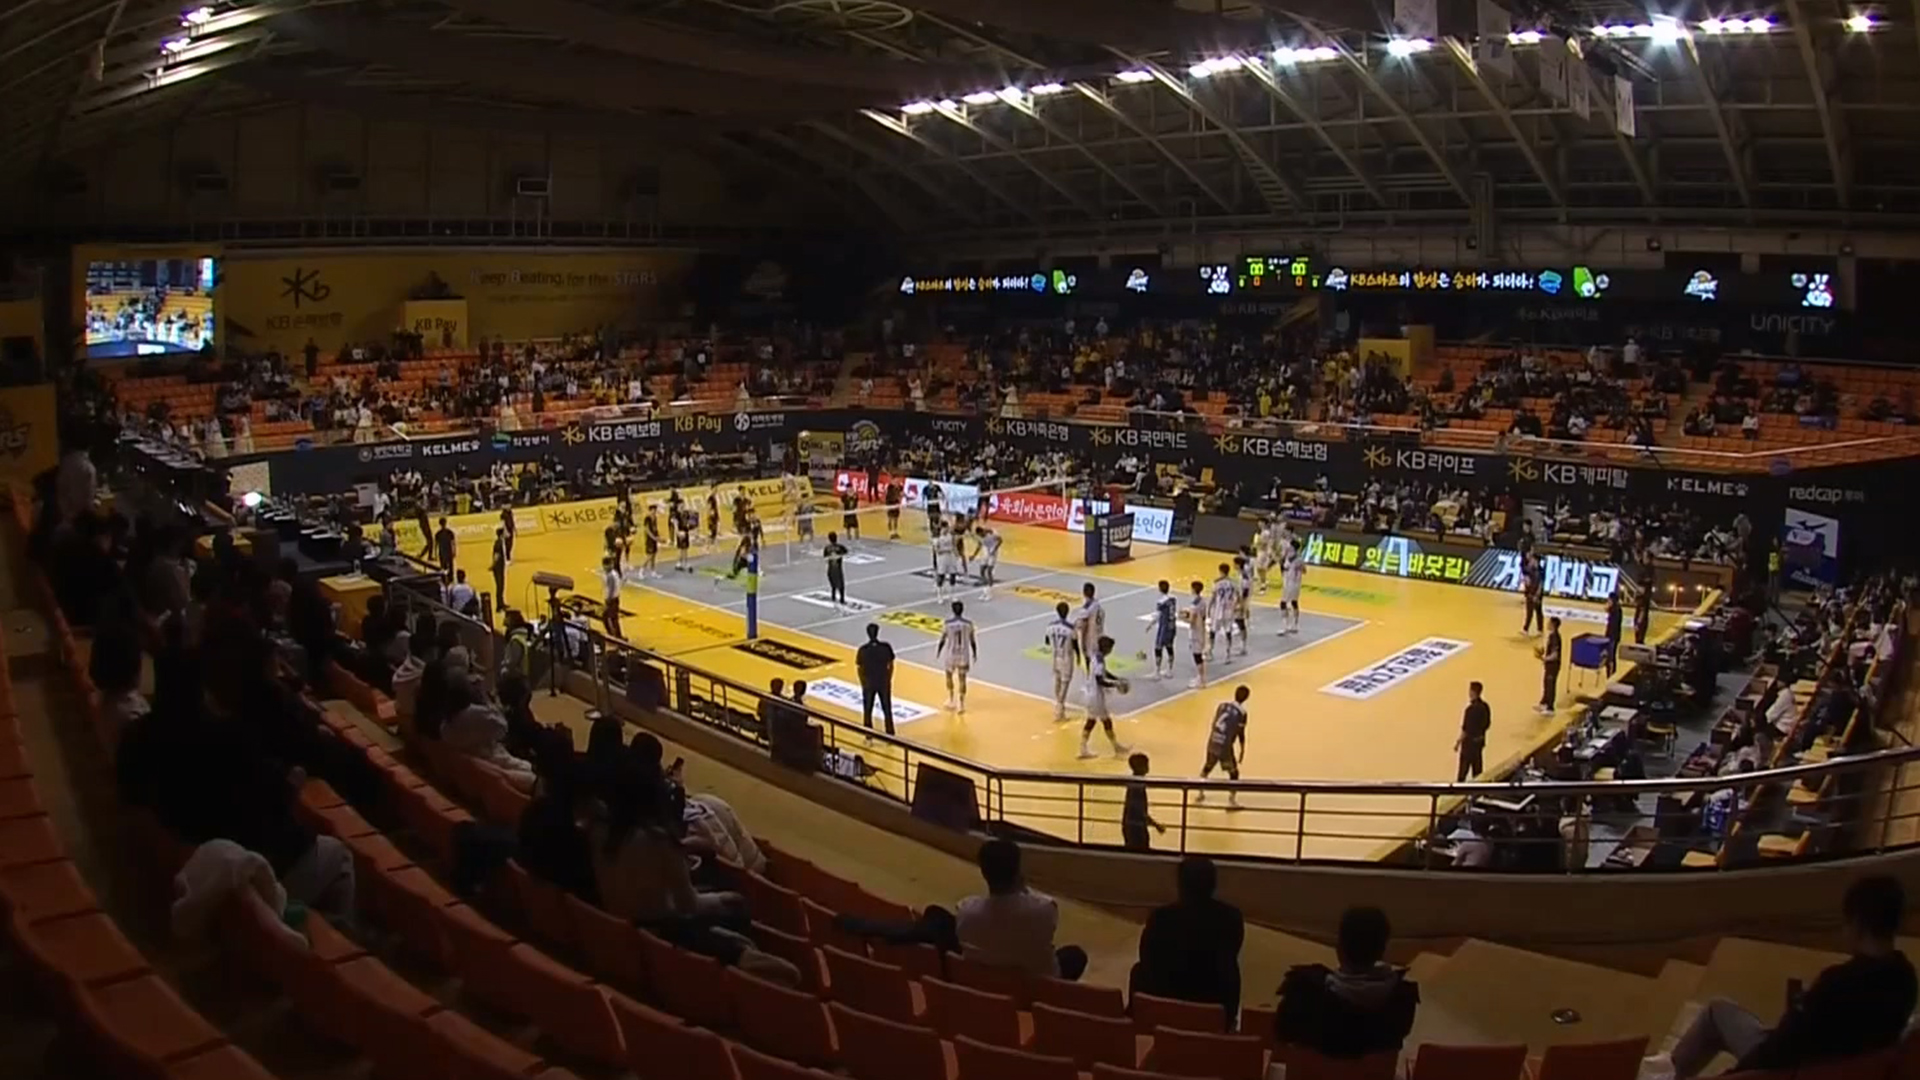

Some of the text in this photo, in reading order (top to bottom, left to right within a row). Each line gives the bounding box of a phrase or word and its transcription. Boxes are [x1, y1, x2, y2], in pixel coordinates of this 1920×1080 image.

[415, 317, 458, 332] KB Pay
[1750, 312, 1836, 335] UNICITY
[675, 414, 722, 433] KB Pay
[422, 444, 470, 457] KELME
[1667, 477, 1734, 496] KELME
[1789, 484, 1842, 504] redcap
